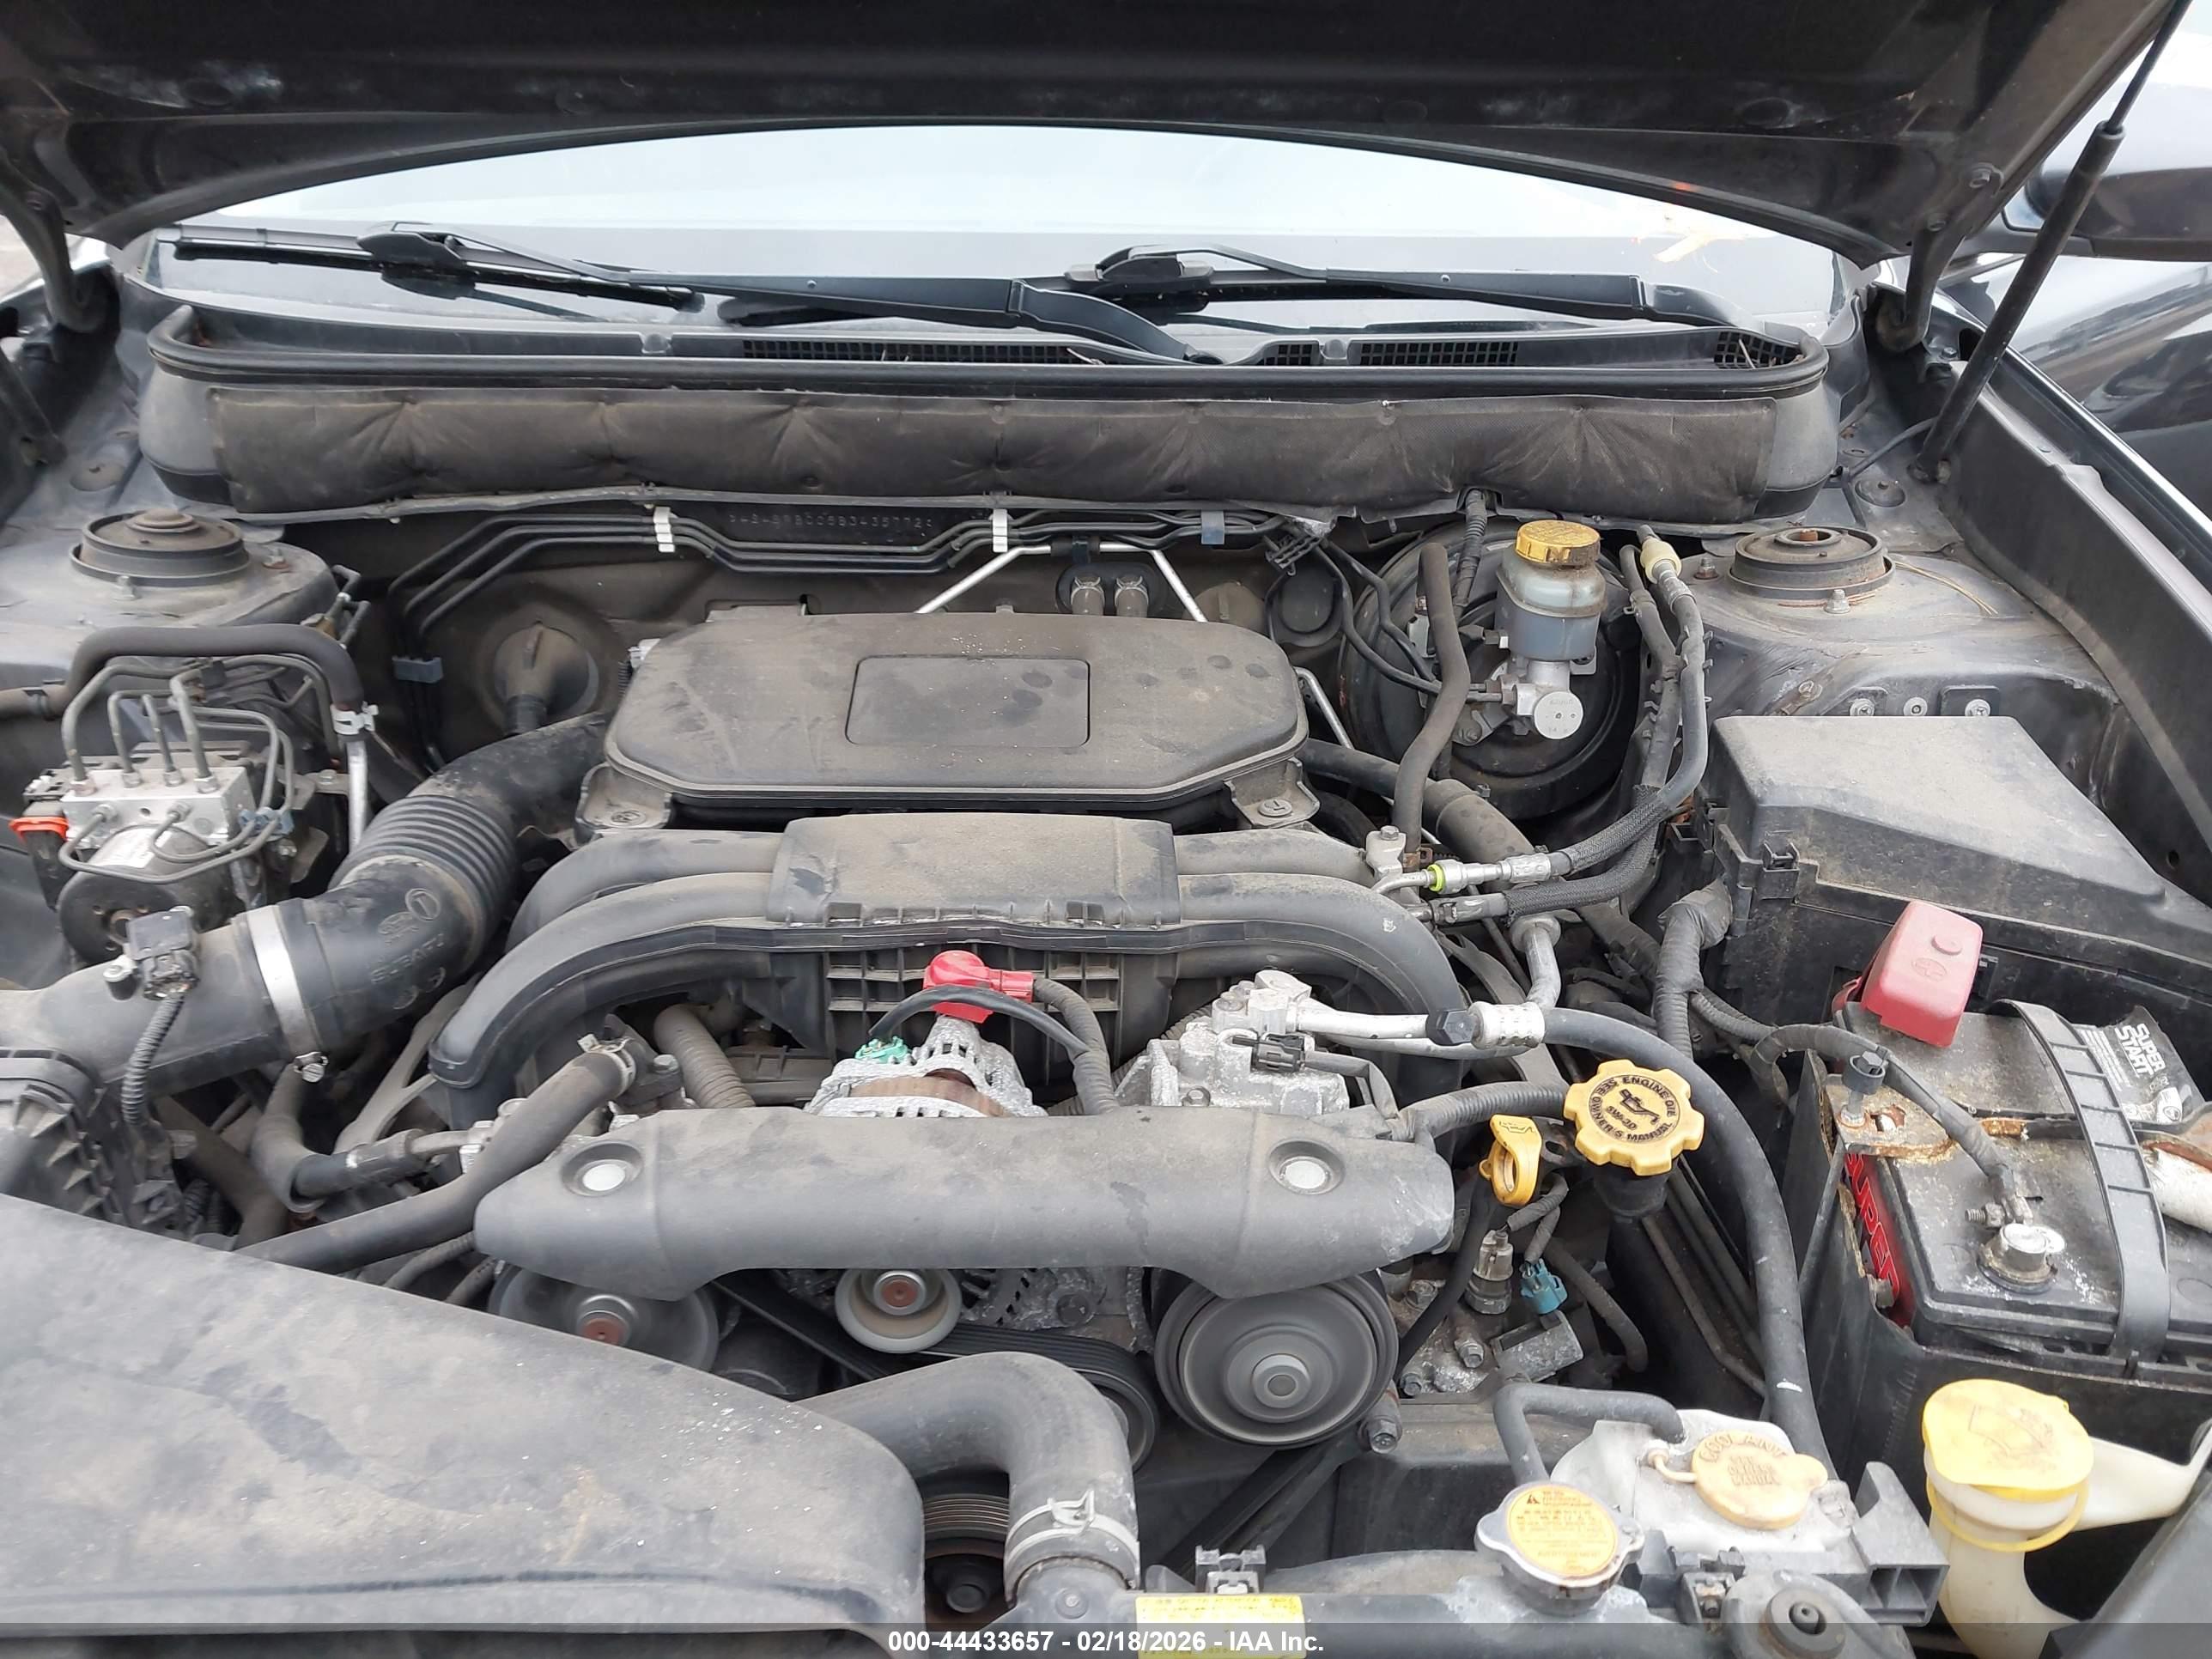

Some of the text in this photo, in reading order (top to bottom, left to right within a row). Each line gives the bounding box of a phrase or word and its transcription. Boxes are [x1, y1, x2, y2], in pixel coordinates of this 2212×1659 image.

[2115, 1024, 2154, 1076] START
[2136, 1023, 2166, 1073] SUPER
[1590, 1078, 1673, 1141] SEE OWNER'S MANUAL
[1622, 1076, 1676, 1118] ENGINE OIL
